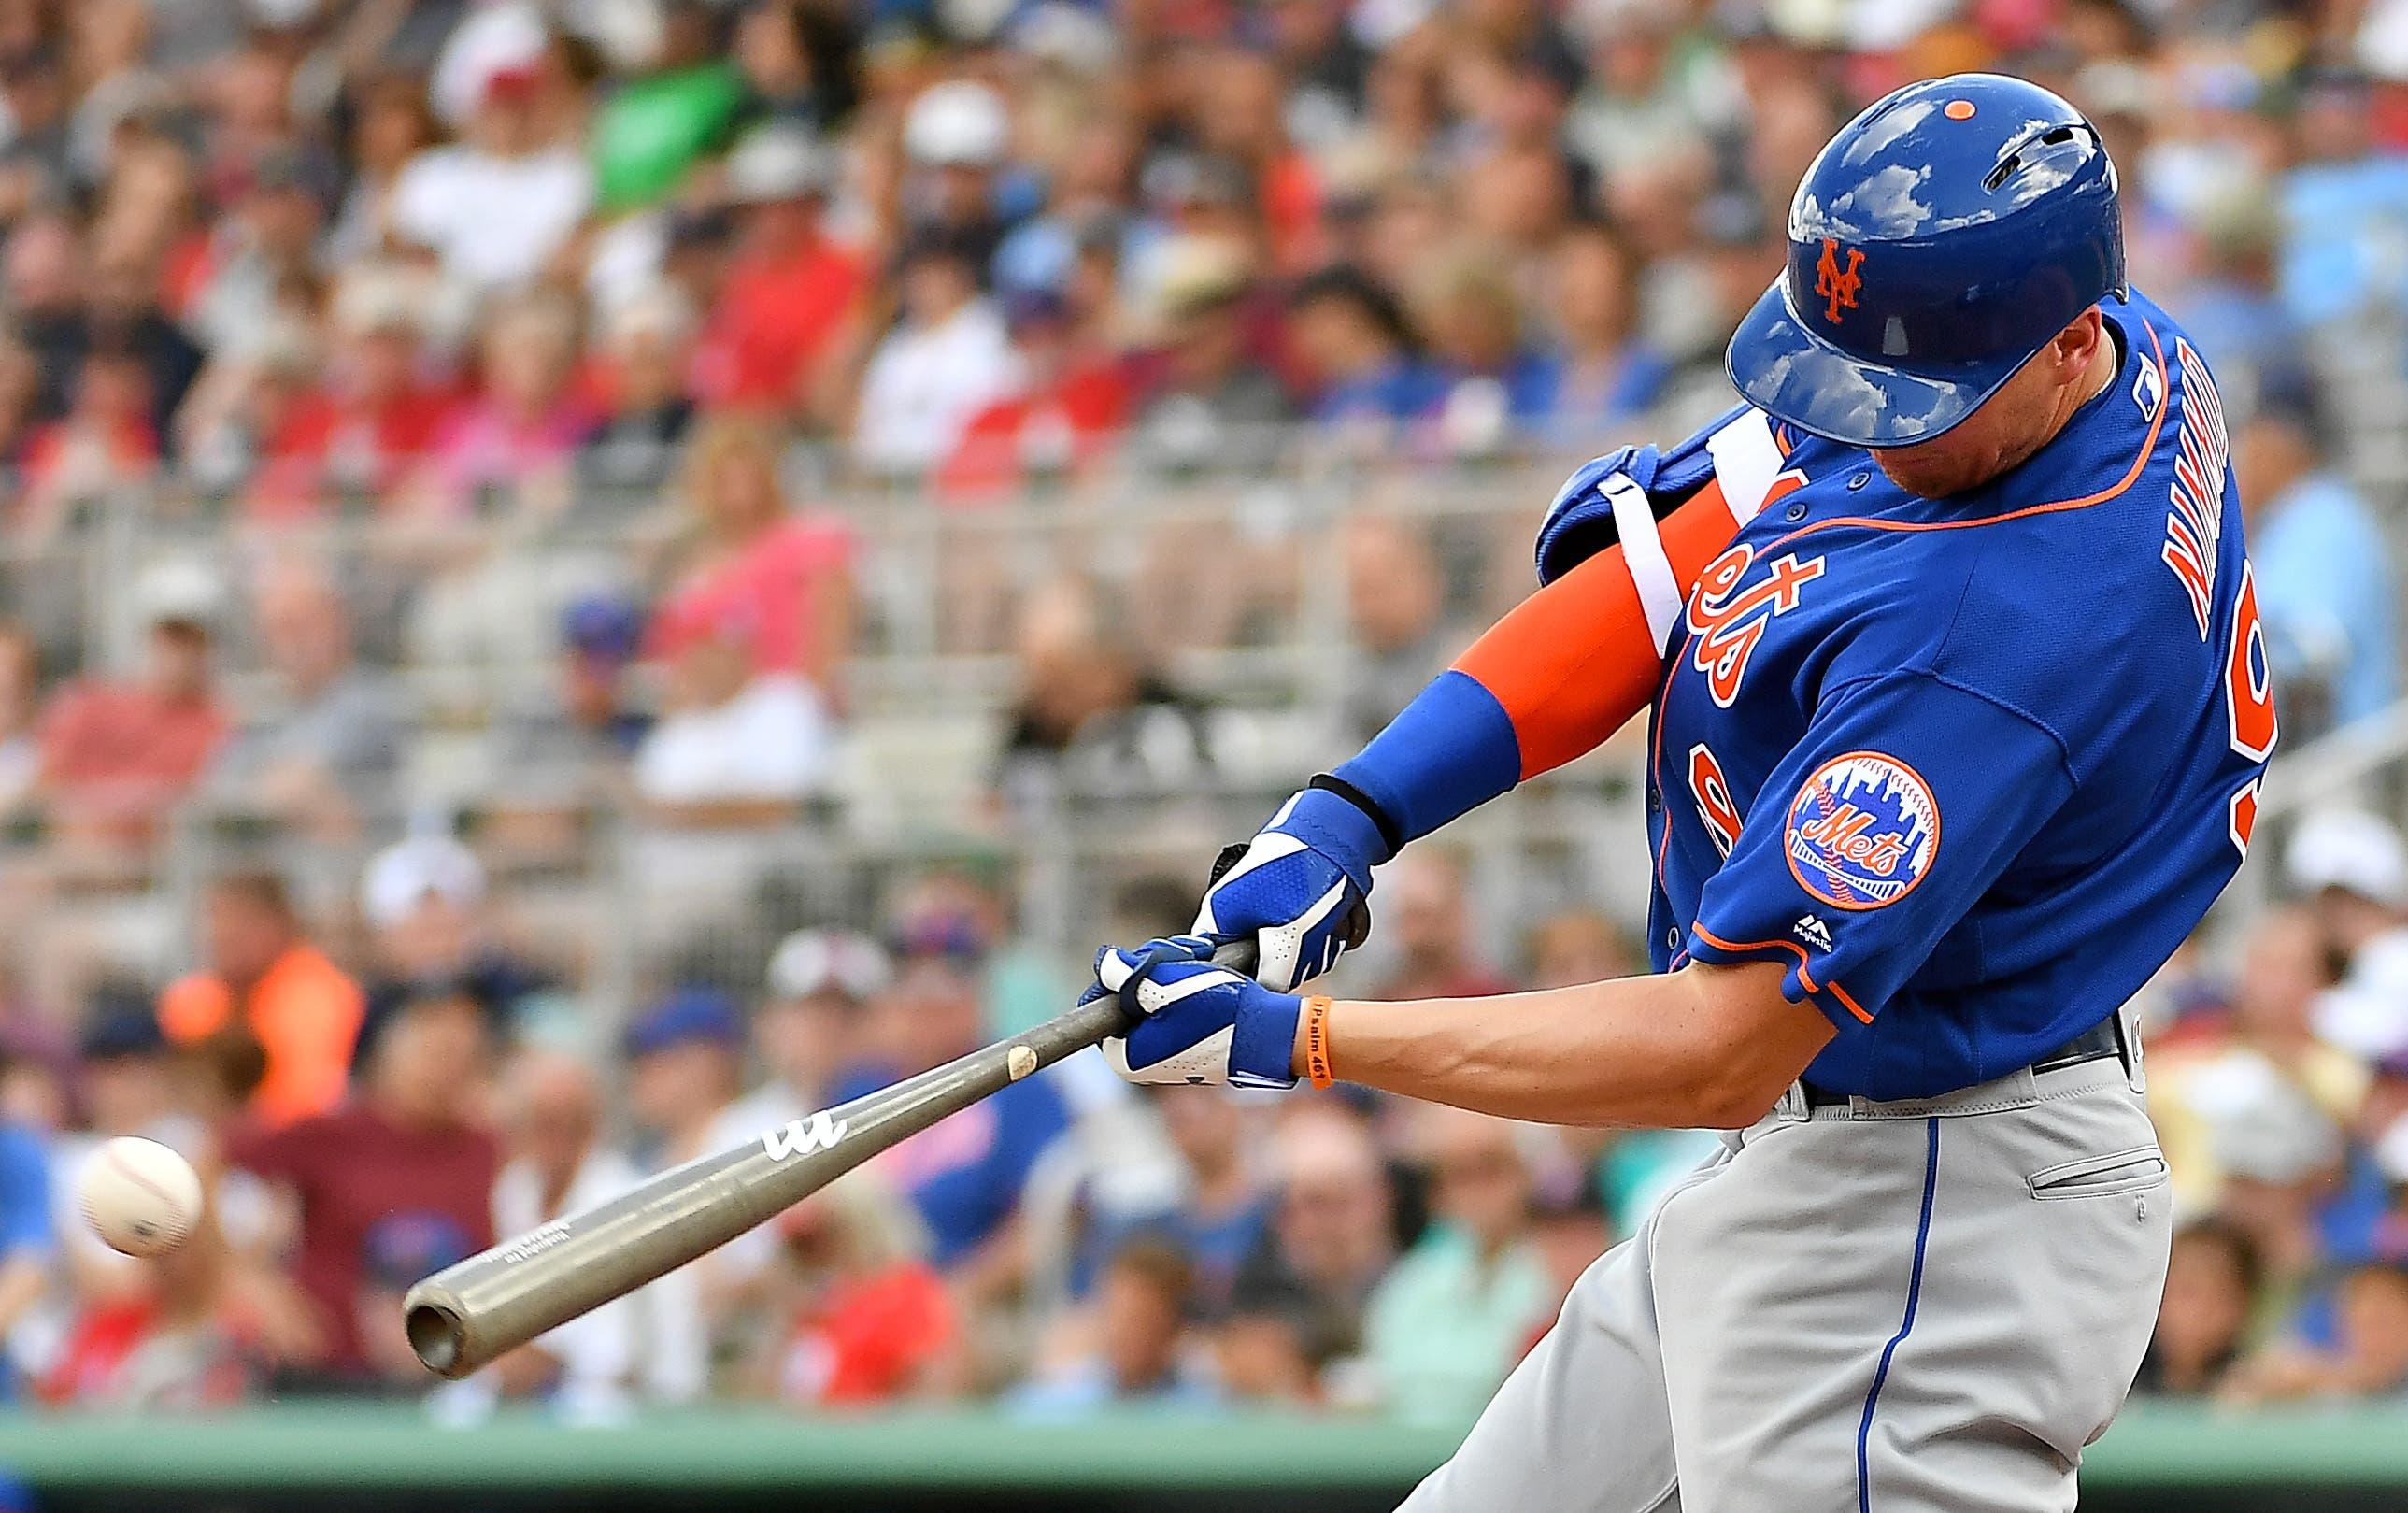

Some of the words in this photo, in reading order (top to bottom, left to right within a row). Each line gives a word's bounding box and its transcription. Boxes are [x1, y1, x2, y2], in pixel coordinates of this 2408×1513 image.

[1686, 468, 1825, 708] ets
[1801, 803, 1910, 877] Mets
[1793, 923, 1832, 953] Majestic
[1310, 1008, 1323, 1052] Psalm
